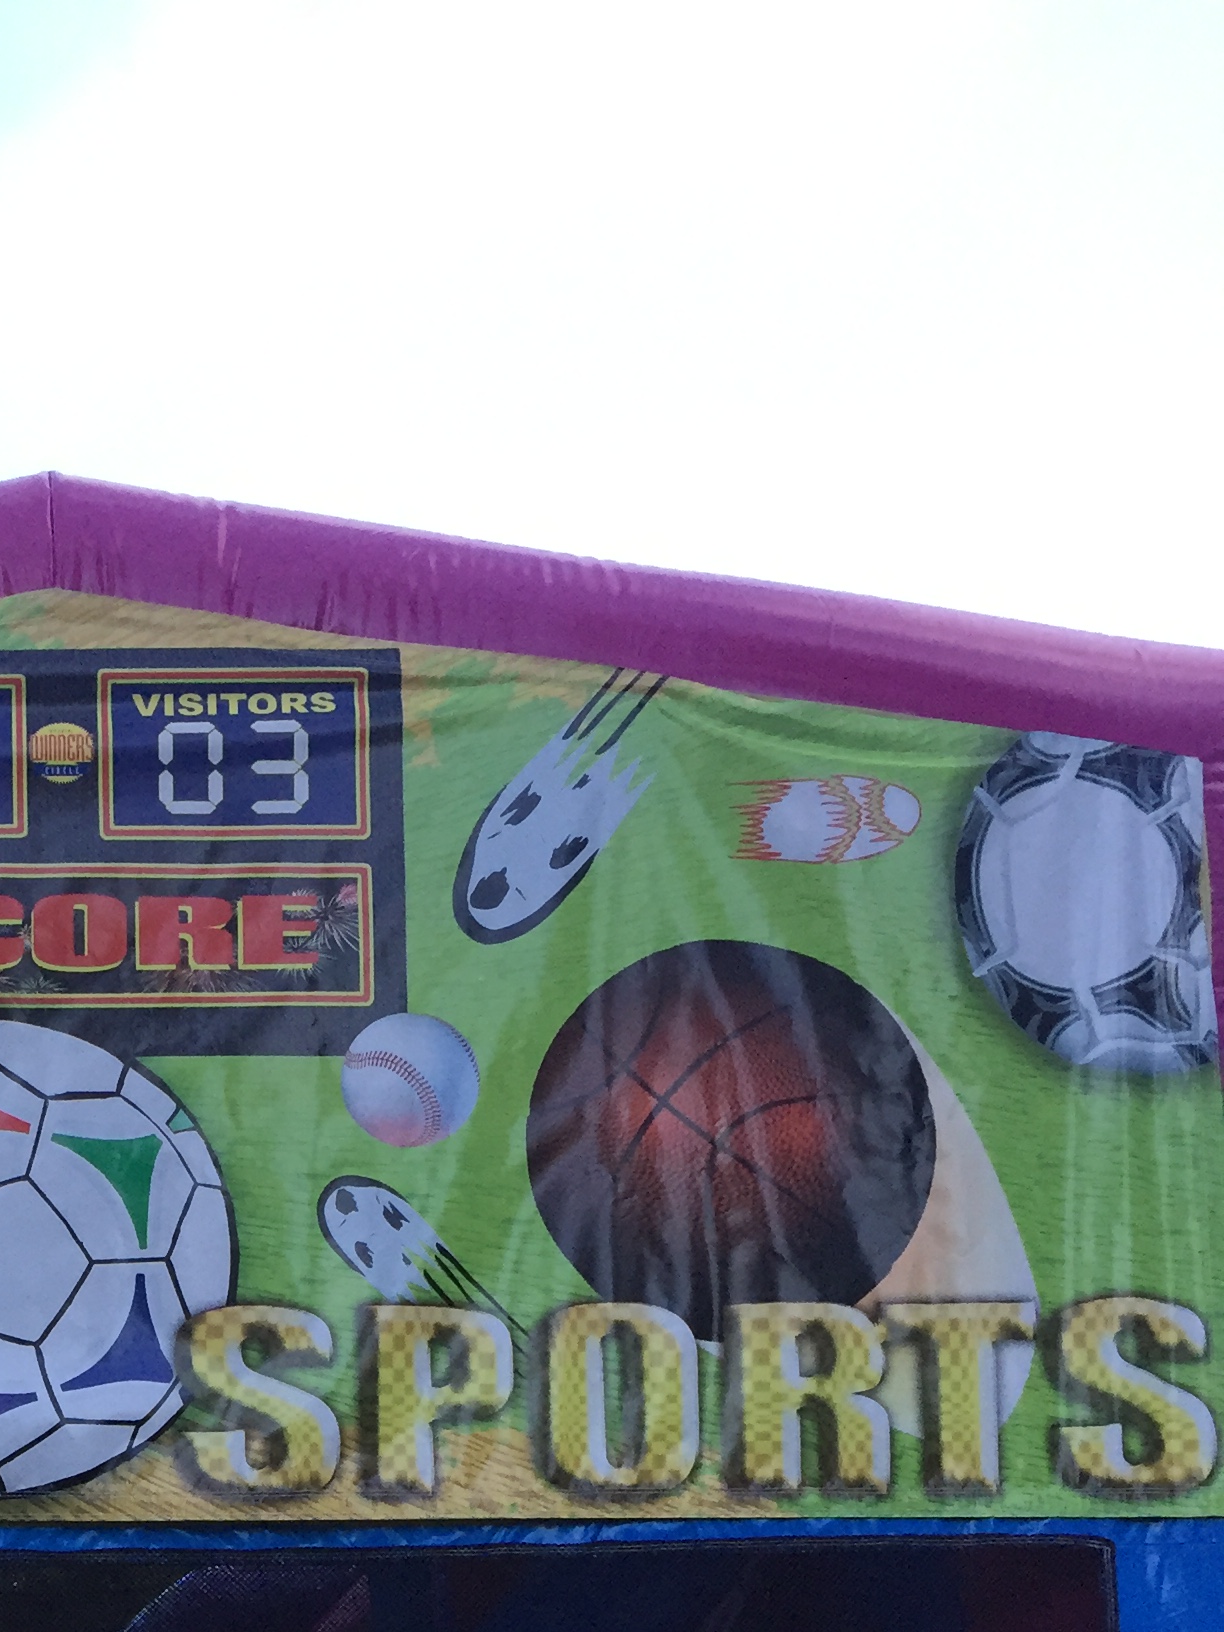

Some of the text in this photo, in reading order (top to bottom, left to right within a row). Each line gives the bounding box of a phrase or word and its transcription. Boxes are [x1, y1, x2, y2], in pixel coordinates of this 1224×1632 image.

[132, 692, 336, 717] VISITORS
[30, 734, 93, 761] WINNERS
[157, 719, 309, 814] 03
[180, 1300, 1217, 1496] SPORTS
